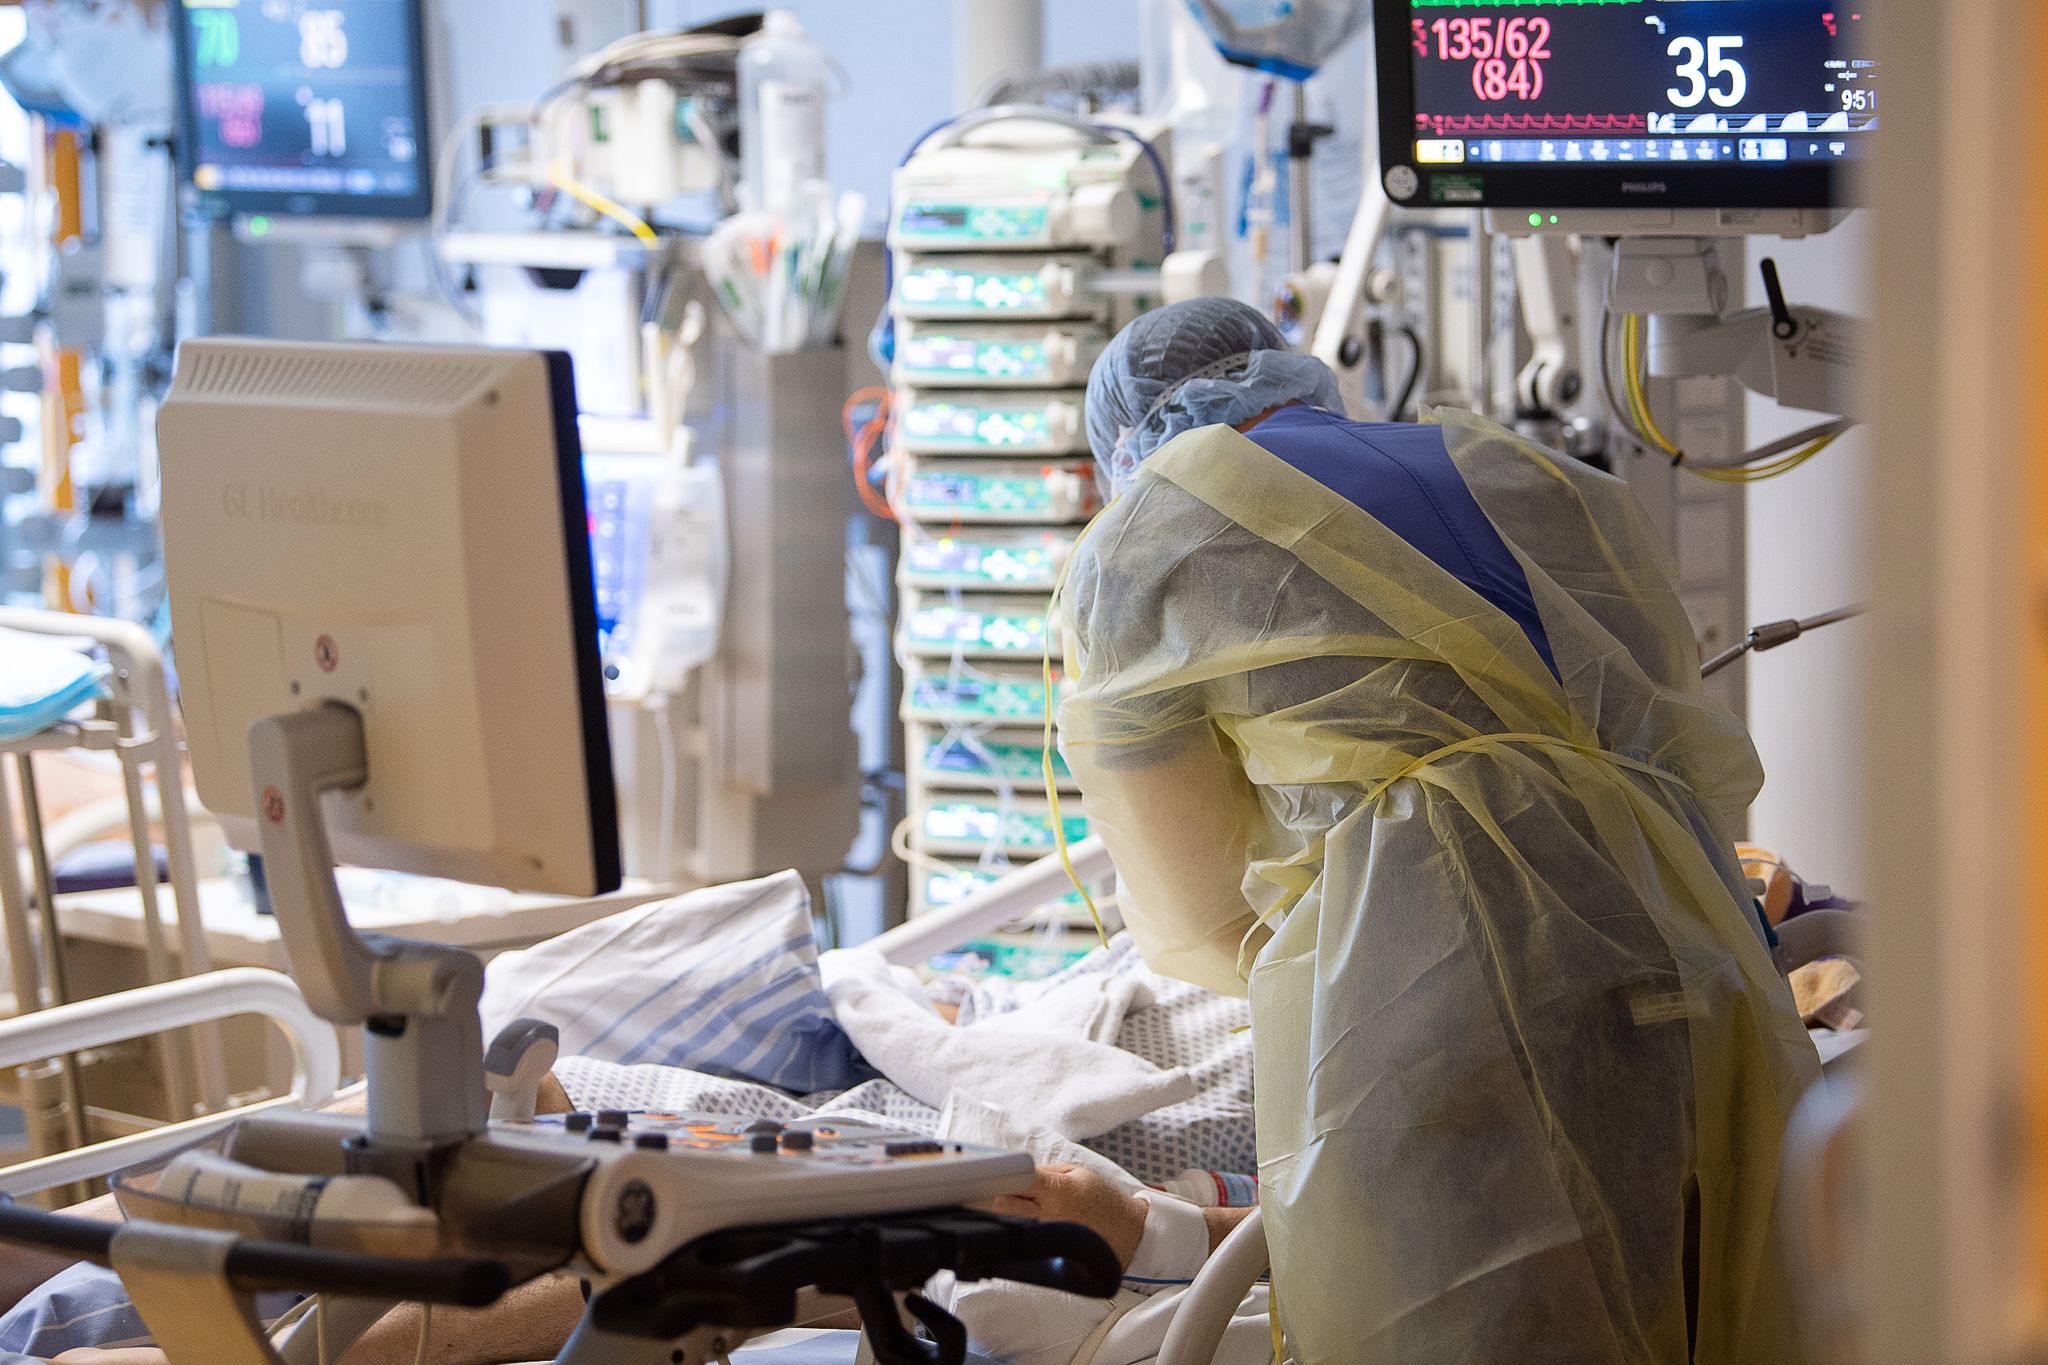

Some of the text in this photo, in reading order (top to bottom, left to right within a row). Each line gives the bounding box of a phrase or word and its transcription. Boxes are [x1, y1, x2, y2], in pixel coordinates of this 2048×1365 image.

[192, 9, 239, 68] 70
[1431, 17, 1551, 60] 135/62
[1472, 58, 1543, 101] (84)
[1666, 35, 1747, 108] 35
